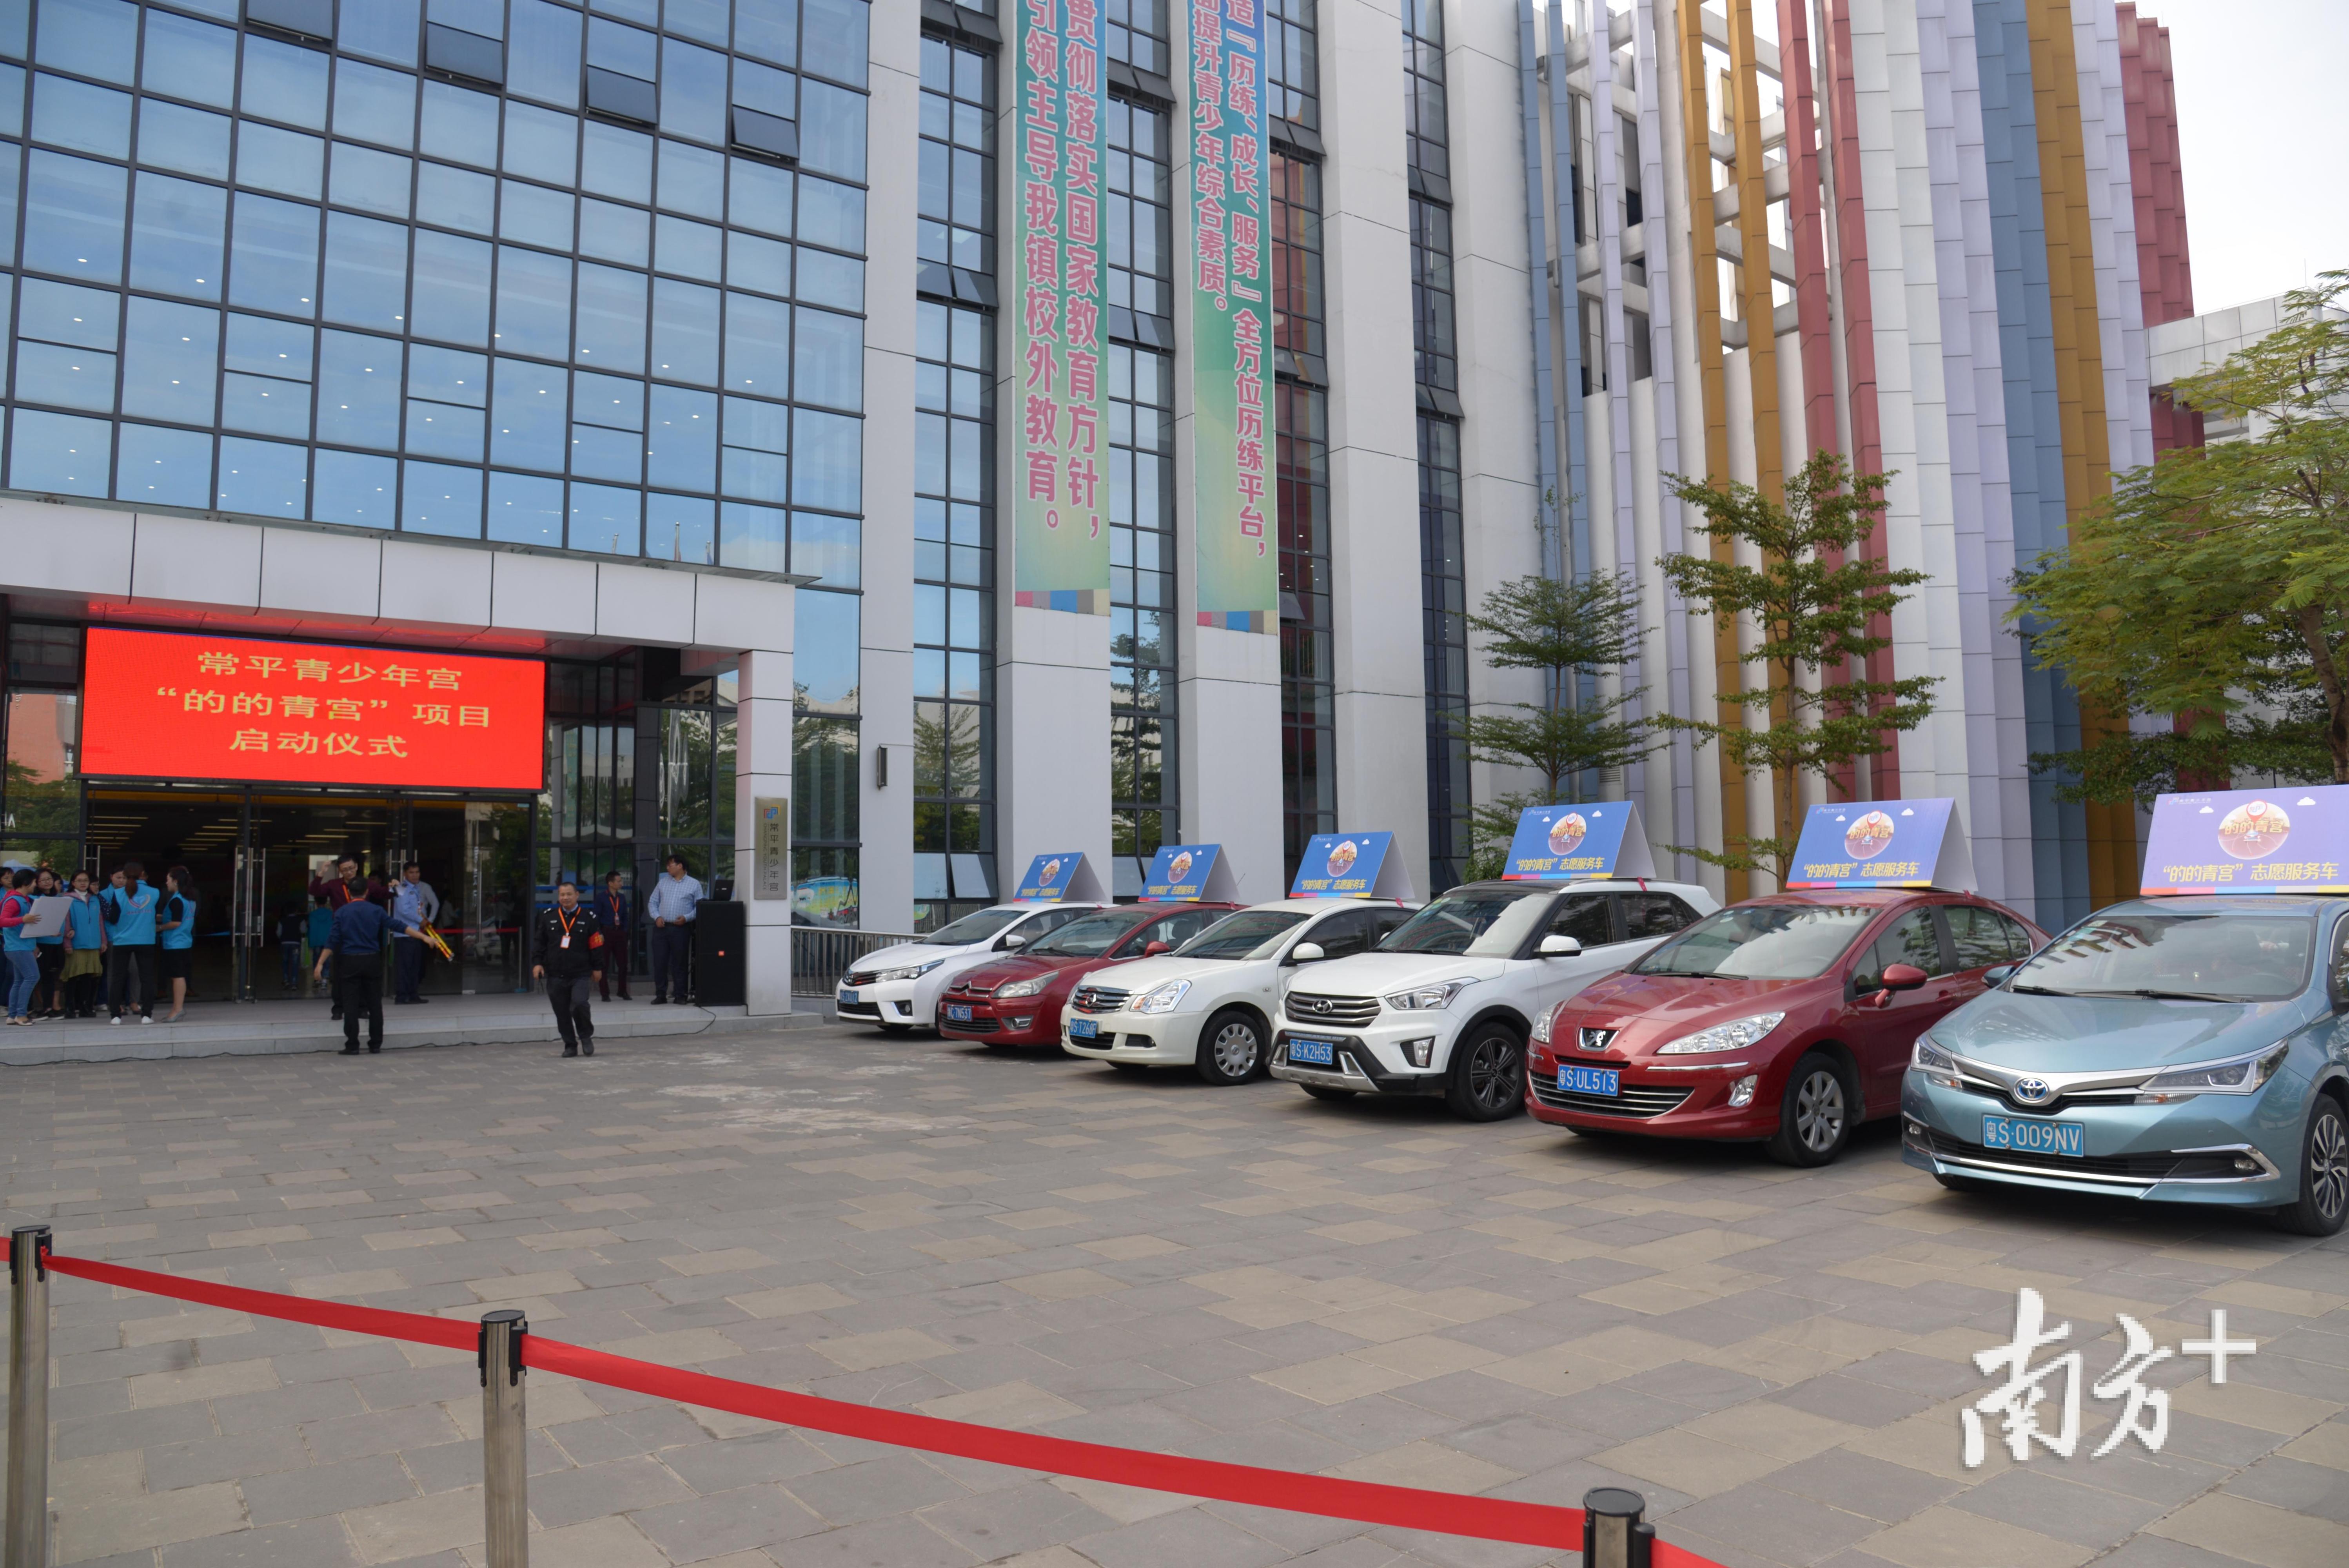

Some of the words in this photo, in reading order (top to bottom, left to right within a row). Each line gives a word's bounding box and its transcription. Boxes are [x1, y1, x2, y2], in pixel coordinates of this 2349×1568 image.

[1026, 0, 1058, 531] 引领主导我镇校外教育。
[1066, 0, 1100, 539] 贯彻落实国家教育方针，
[198, 650, 462, 690] 常平青少年宫
[157, 687, 388, 722] “的的青宫”
[412, 703, 490, 728] 项目
[230, 728, 408, 758] 启动仪式
[1850, 827, 1890, 840] 的的青宫
[2224, 820, 2284, 835] 的的青宫
[770, 822, 779, 892] 常平青少年宫
[1516, 858, 1558, 871] “的的青宫”
[1559, 857, 1605, 870] 志愿服务车
[1804, 862, 1858, 878] “的的青宫”
[1861, 862, 1920, 877] 志愿服务车
[2164, 863, 2243, 882] “的的青宫”
[2250, 862, 2339, 881] 志愿服务车
[1332, 879, 1367, 890] 志愿服务车
[1291, 1042, 1331, 1061] 粤S·K2H53
[1559, 1069, 1616, 1092] 粤S·UL513
[1986, 1121, 2080, 1151] 粤S·009NV
